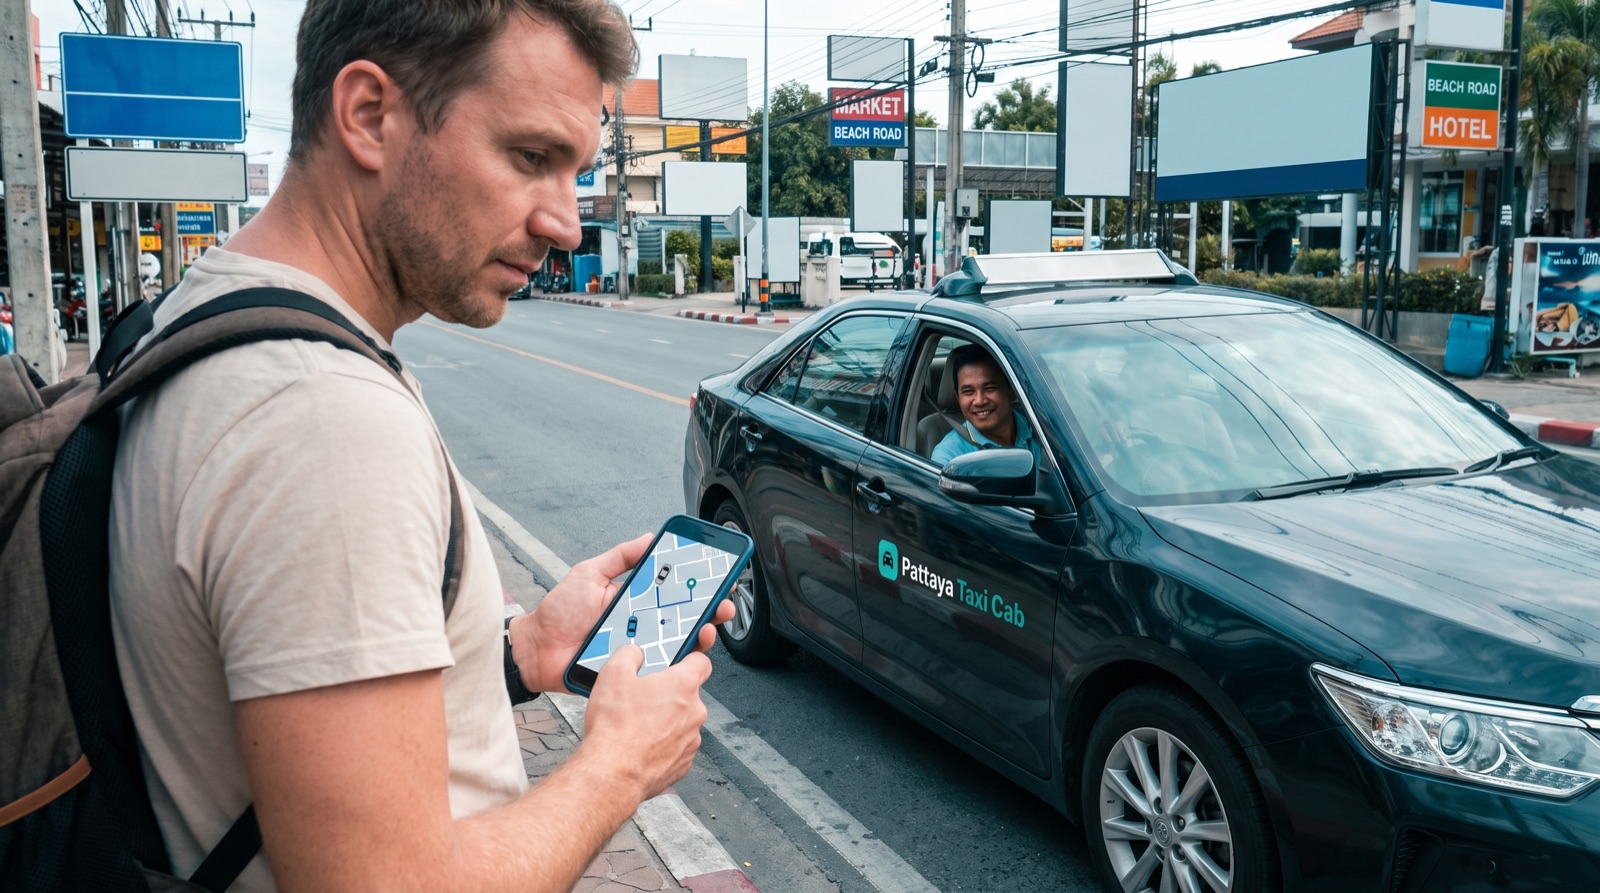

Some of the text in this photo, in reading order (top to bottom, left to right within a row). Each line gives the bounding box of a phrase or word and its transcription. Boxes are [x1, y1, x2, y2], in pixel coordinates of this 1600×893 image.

[1427, 78, 1497, 96] BEACH ROAD
[835, 95, 901, 116] MARKET
[834, 126, 902, 140] BEACH ROAD
[1429, 116, 1492, 140] HOTEL
[901, 556, 1025, 628] Pattaya Taxi Cab
